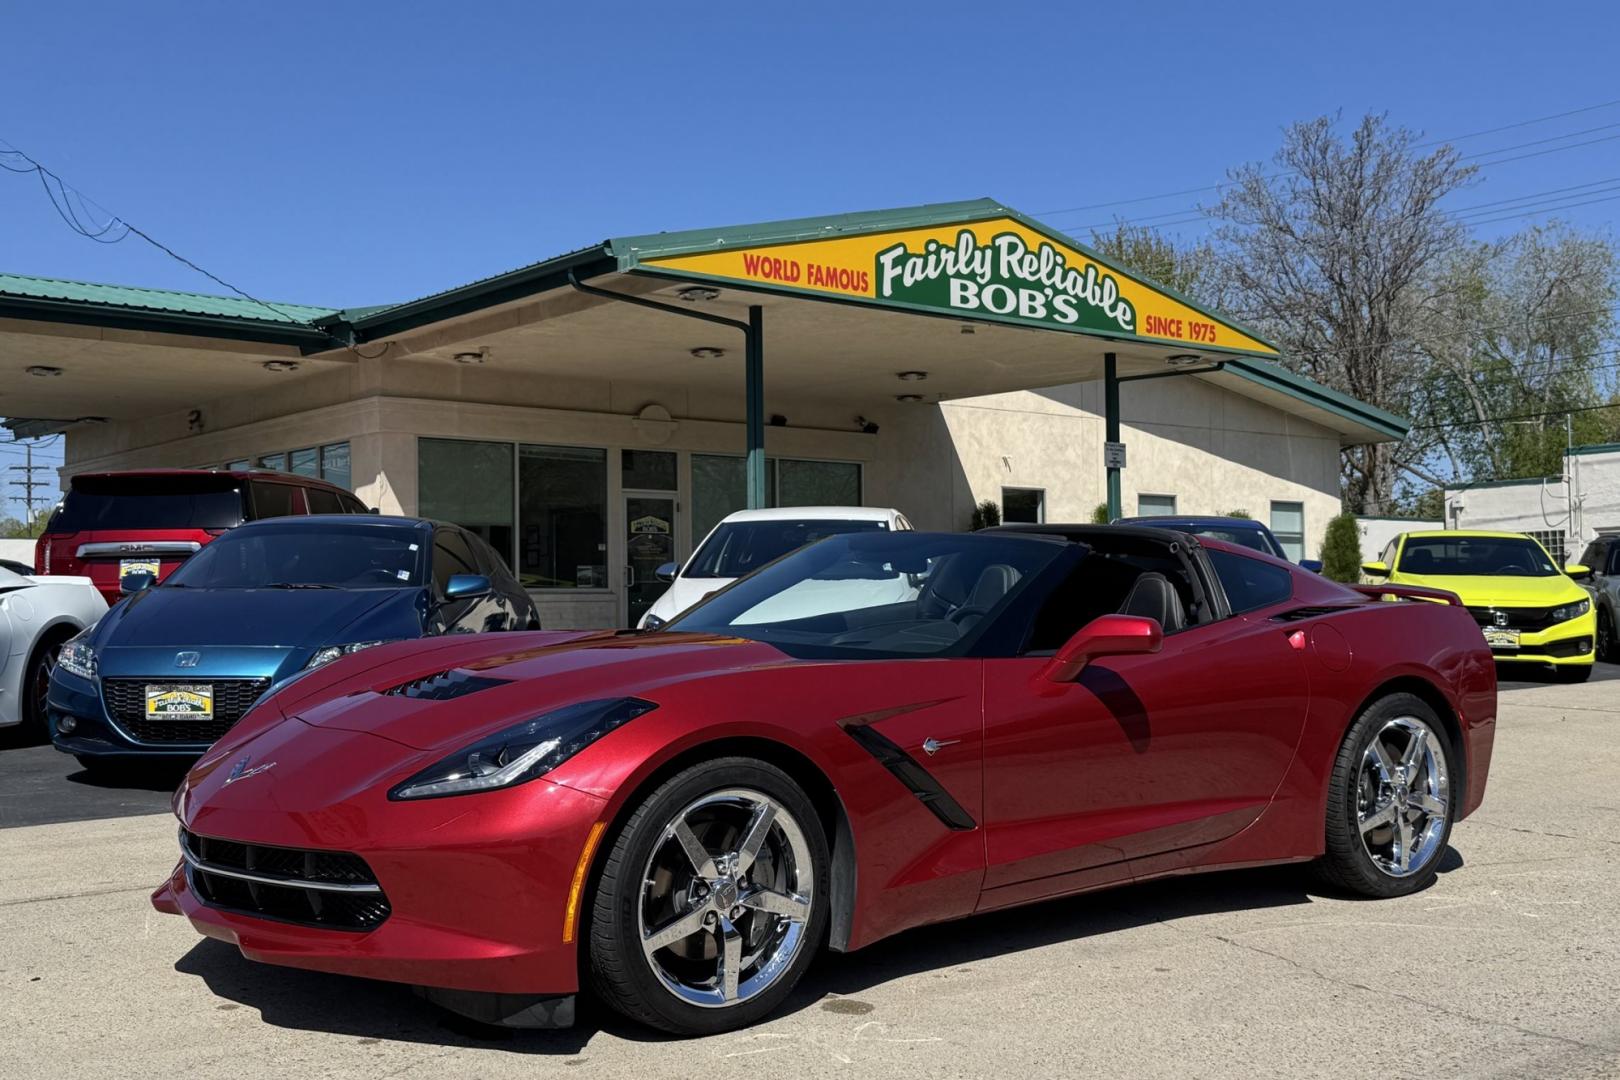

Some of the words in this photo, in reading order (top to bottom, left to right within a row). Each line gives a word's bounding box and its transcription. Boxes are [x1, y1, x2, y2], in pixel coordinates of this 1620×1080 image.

[743, 253, 801, 283] WORLD
[807, 263, 869, 293] FAMOUS
[879, 229, 993, 297] Fairly
[992, 234, 1134, 330] Reliable
[950, 277, 1079, 324] BOB'S
[1145, 314, 1183, 339] SINCE
[1188, 321, 1216, 343] 1975
[119, 544, 154, 552] GMC
